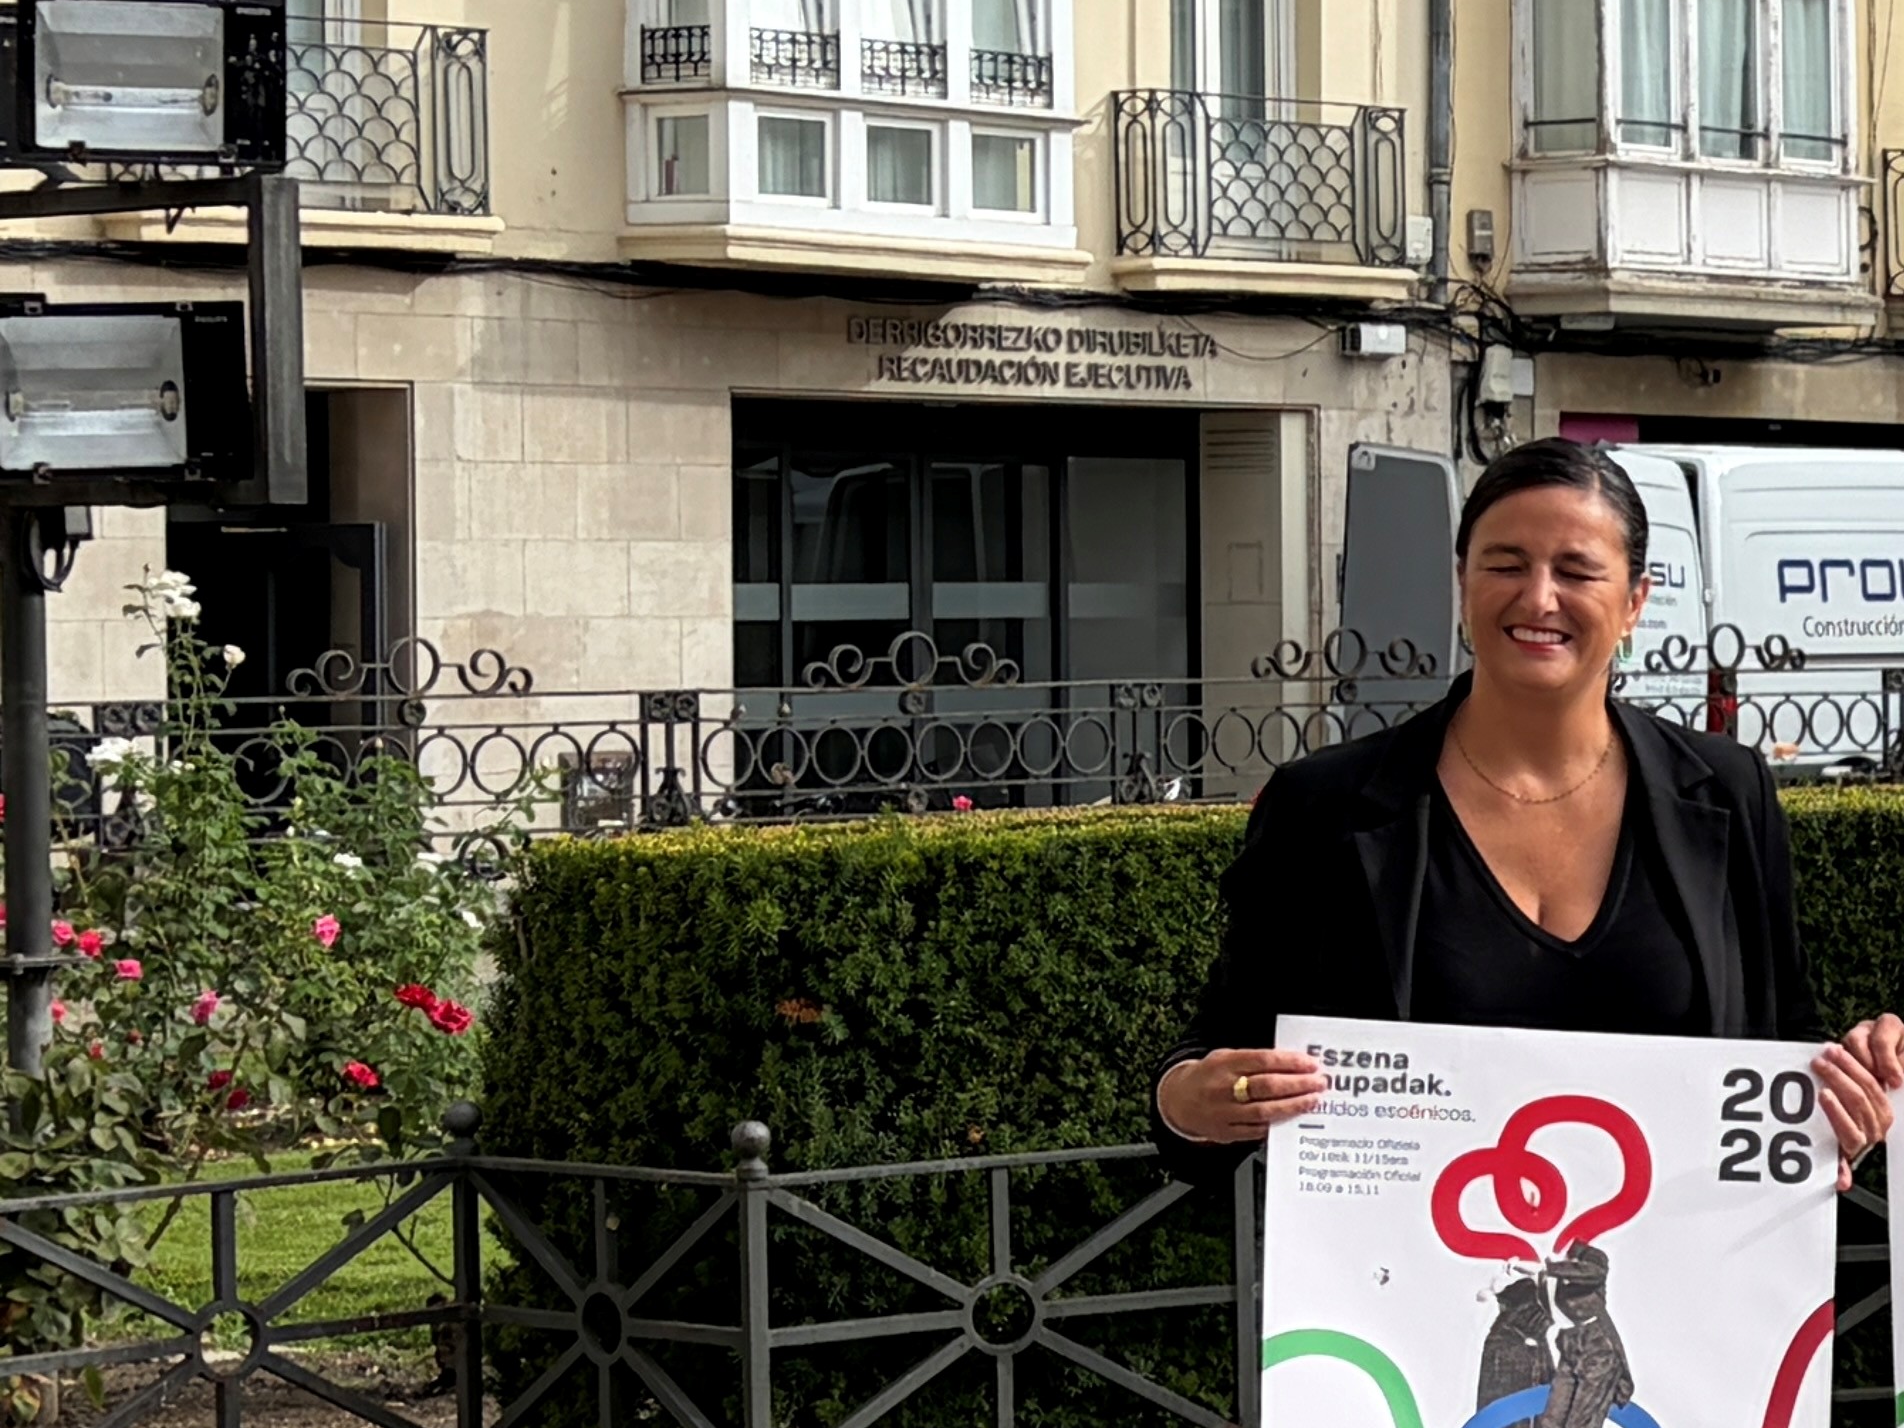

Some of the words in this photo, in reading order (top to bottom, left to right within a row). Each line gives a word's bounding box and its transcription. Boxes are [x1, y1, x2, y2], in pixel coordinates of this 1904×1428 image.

[847, 316, 1063, 352] DERRIGORREZKO
[1066, 325, 1219, 359] DIRUBILKETA
[877, 354, 1059, 386] RECAUDACIÓN
[1063, 363, 1193, 391] EJECUTIVA
[1721, 1069, 1815, 1124] 20
[1718, 1128, 1812, 1184] 26
